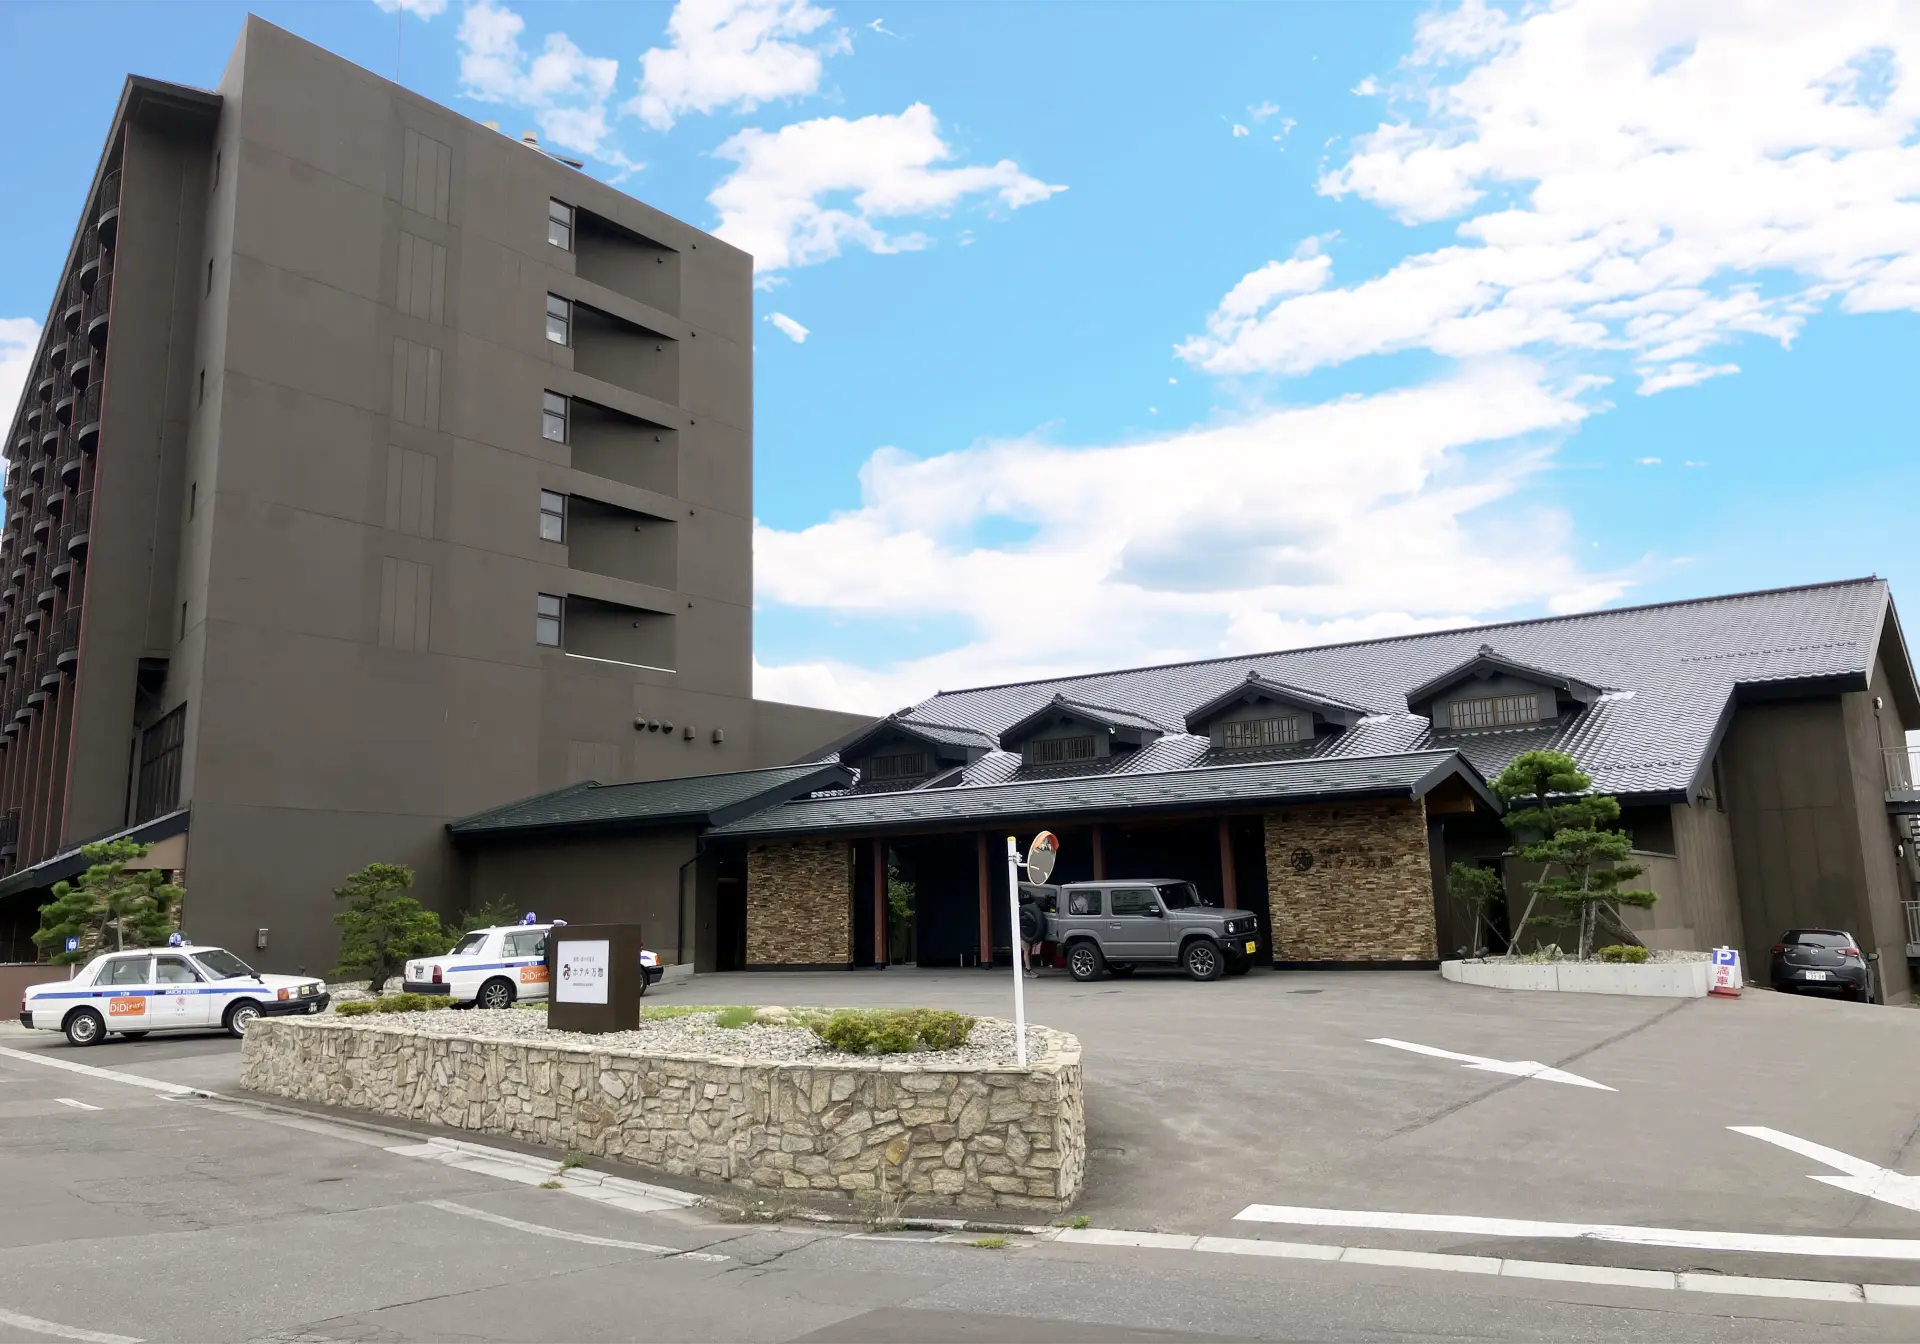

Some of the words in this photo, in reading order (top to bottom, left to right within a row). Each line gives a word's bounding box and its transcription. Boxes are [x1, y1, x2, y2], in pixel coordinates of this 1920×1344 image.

[1717, 950, 1732, 965] P
[521, 972, 537, 980] DiDi
[111, 1003, 128, 1013] DiDi
